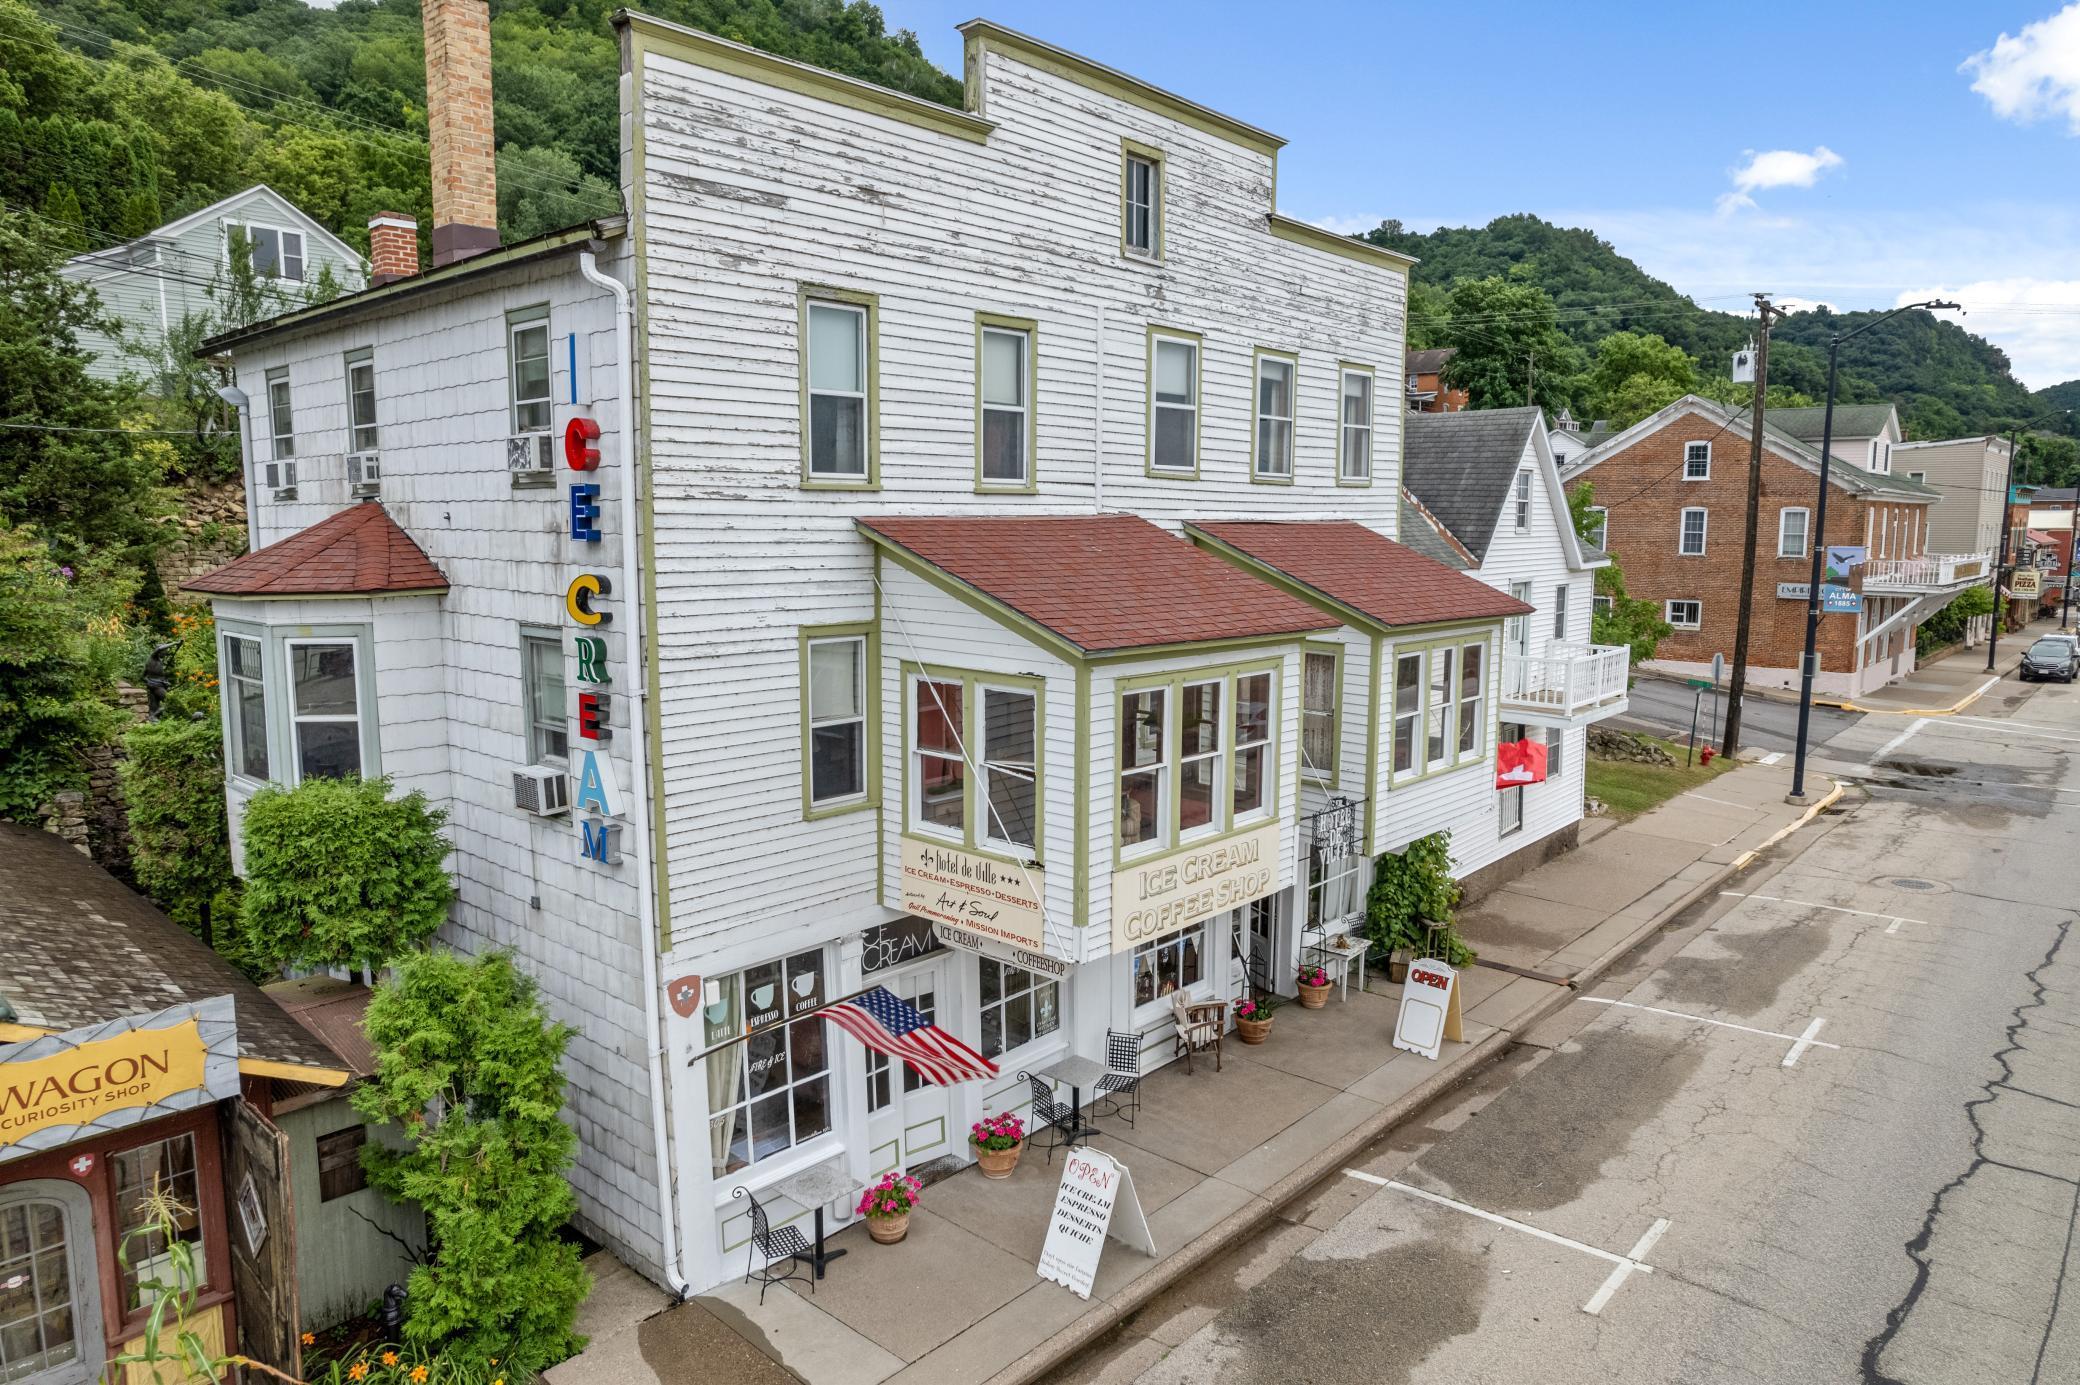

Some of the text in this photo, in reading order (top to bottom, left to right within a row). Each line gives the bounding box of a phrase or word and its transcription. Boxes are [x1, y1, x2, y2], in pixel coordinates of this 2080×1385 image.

[565, 333, 622, 865] ICE CREAM
[1829, 592, 1856, 600] ALMA
[1139, 838, 1259, 900] ICE CREAM
[904, 865, 1039, 910] ICE CREAM ESPRESSO DESSERTS
[935, 892, 956, 911] Art
[969, 901, 999, 922] Soul
[1124, 868, 1270, 941] COFFEE SHOP
[940, 925, 979, 950] ICE CREAM
[966, 918, 999, 936] MISSION
[1000, 929, 1039, 948] IMPORTS
[862, 928, 931, 971] CREAM
[1016, 950, 1065, 977] COFFEESHOP
[1411, 968, 1450, 990] OPEN
[750, 1009, 779, 1028] ESPRESSO
[796, 997, 817, 1012] COFFEE
[1, 1082, 151, 1130] CURIOSITY SHOP
[1068, 1158, 1112, 1189] OPEN
[1060, 1195, 1107, 1222] ESPRESSO
[1061, 1182, 1111, 1210] ICE CREAM
[1057, 1208, 1103, 1235] DESSERTS
[1058, 1223, 1094, 1245] QUICHE
